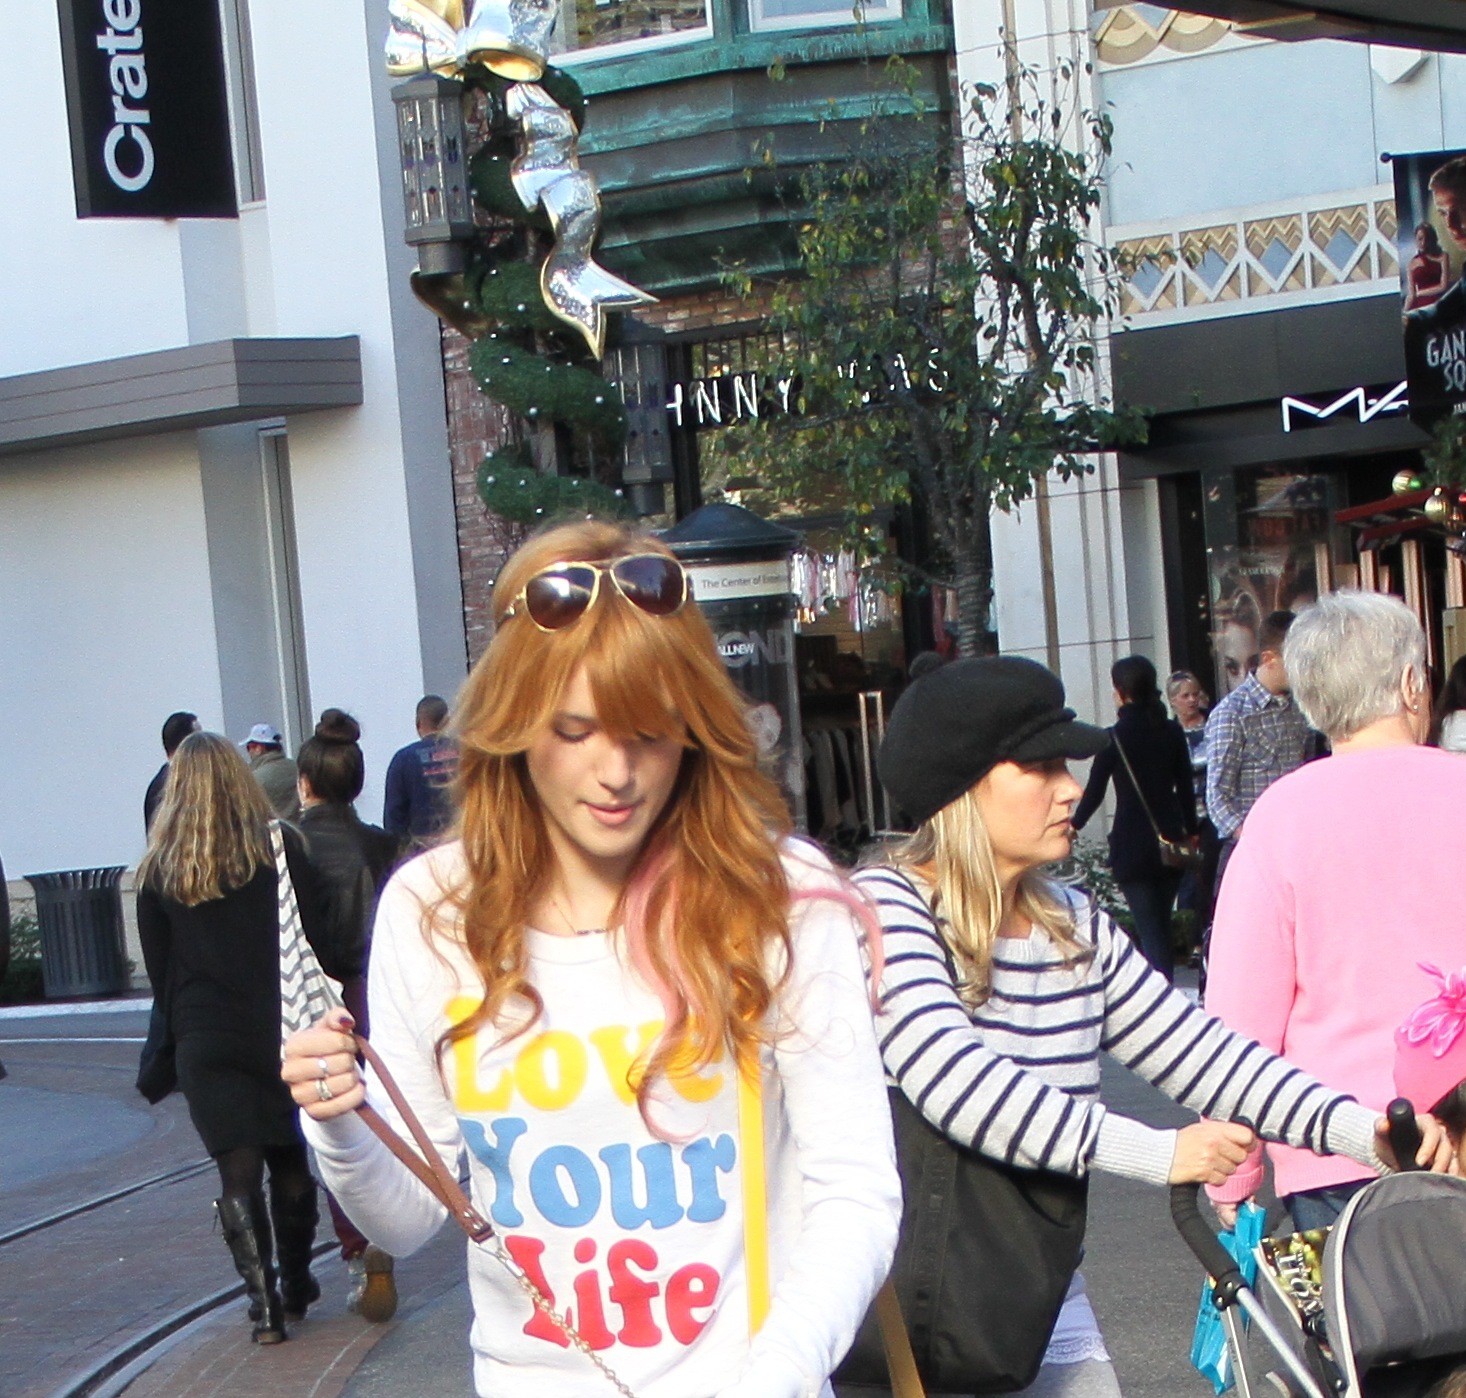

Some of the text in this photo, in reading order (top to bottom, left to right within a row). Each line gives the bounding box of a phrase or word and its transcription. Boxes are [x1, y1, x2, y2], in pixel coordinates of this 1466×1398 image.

[96, 0, 155, 192] Crate
[702, 578, 720, 589] The
[721, 577, 751, 588] Center
[457, 1116, 737, 1230] Your
[504, 1234, 720, 1351] Life
